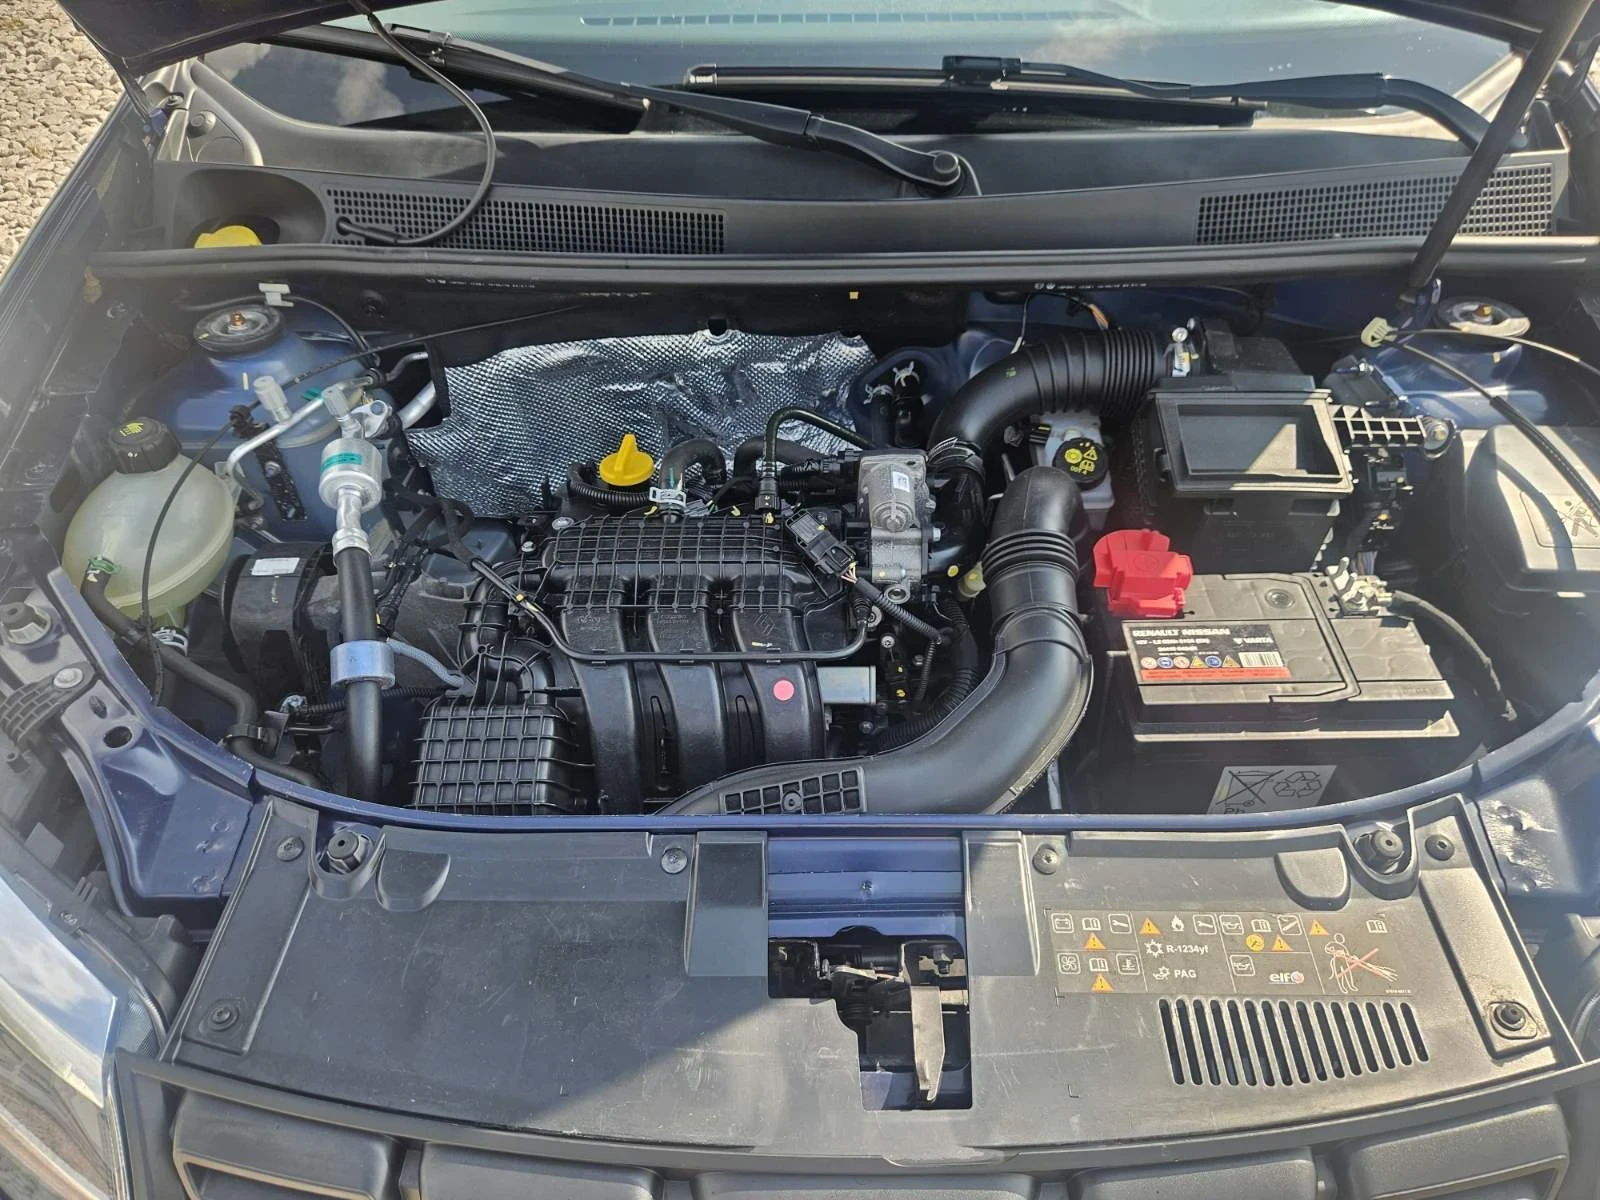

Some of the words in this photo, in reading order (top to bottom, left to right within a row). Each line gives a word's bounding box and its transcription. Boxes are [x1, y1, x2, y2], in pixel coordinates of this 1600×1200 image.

[1132, 629, 1180, 637] RENAULT
[1181, 628, 1231, 636] NISSAN
[1166, 944, 1209, 956] R-1234yf
[1173, 969, 1197, 979] PAG
[1268, 971, 1292, 982] elf
